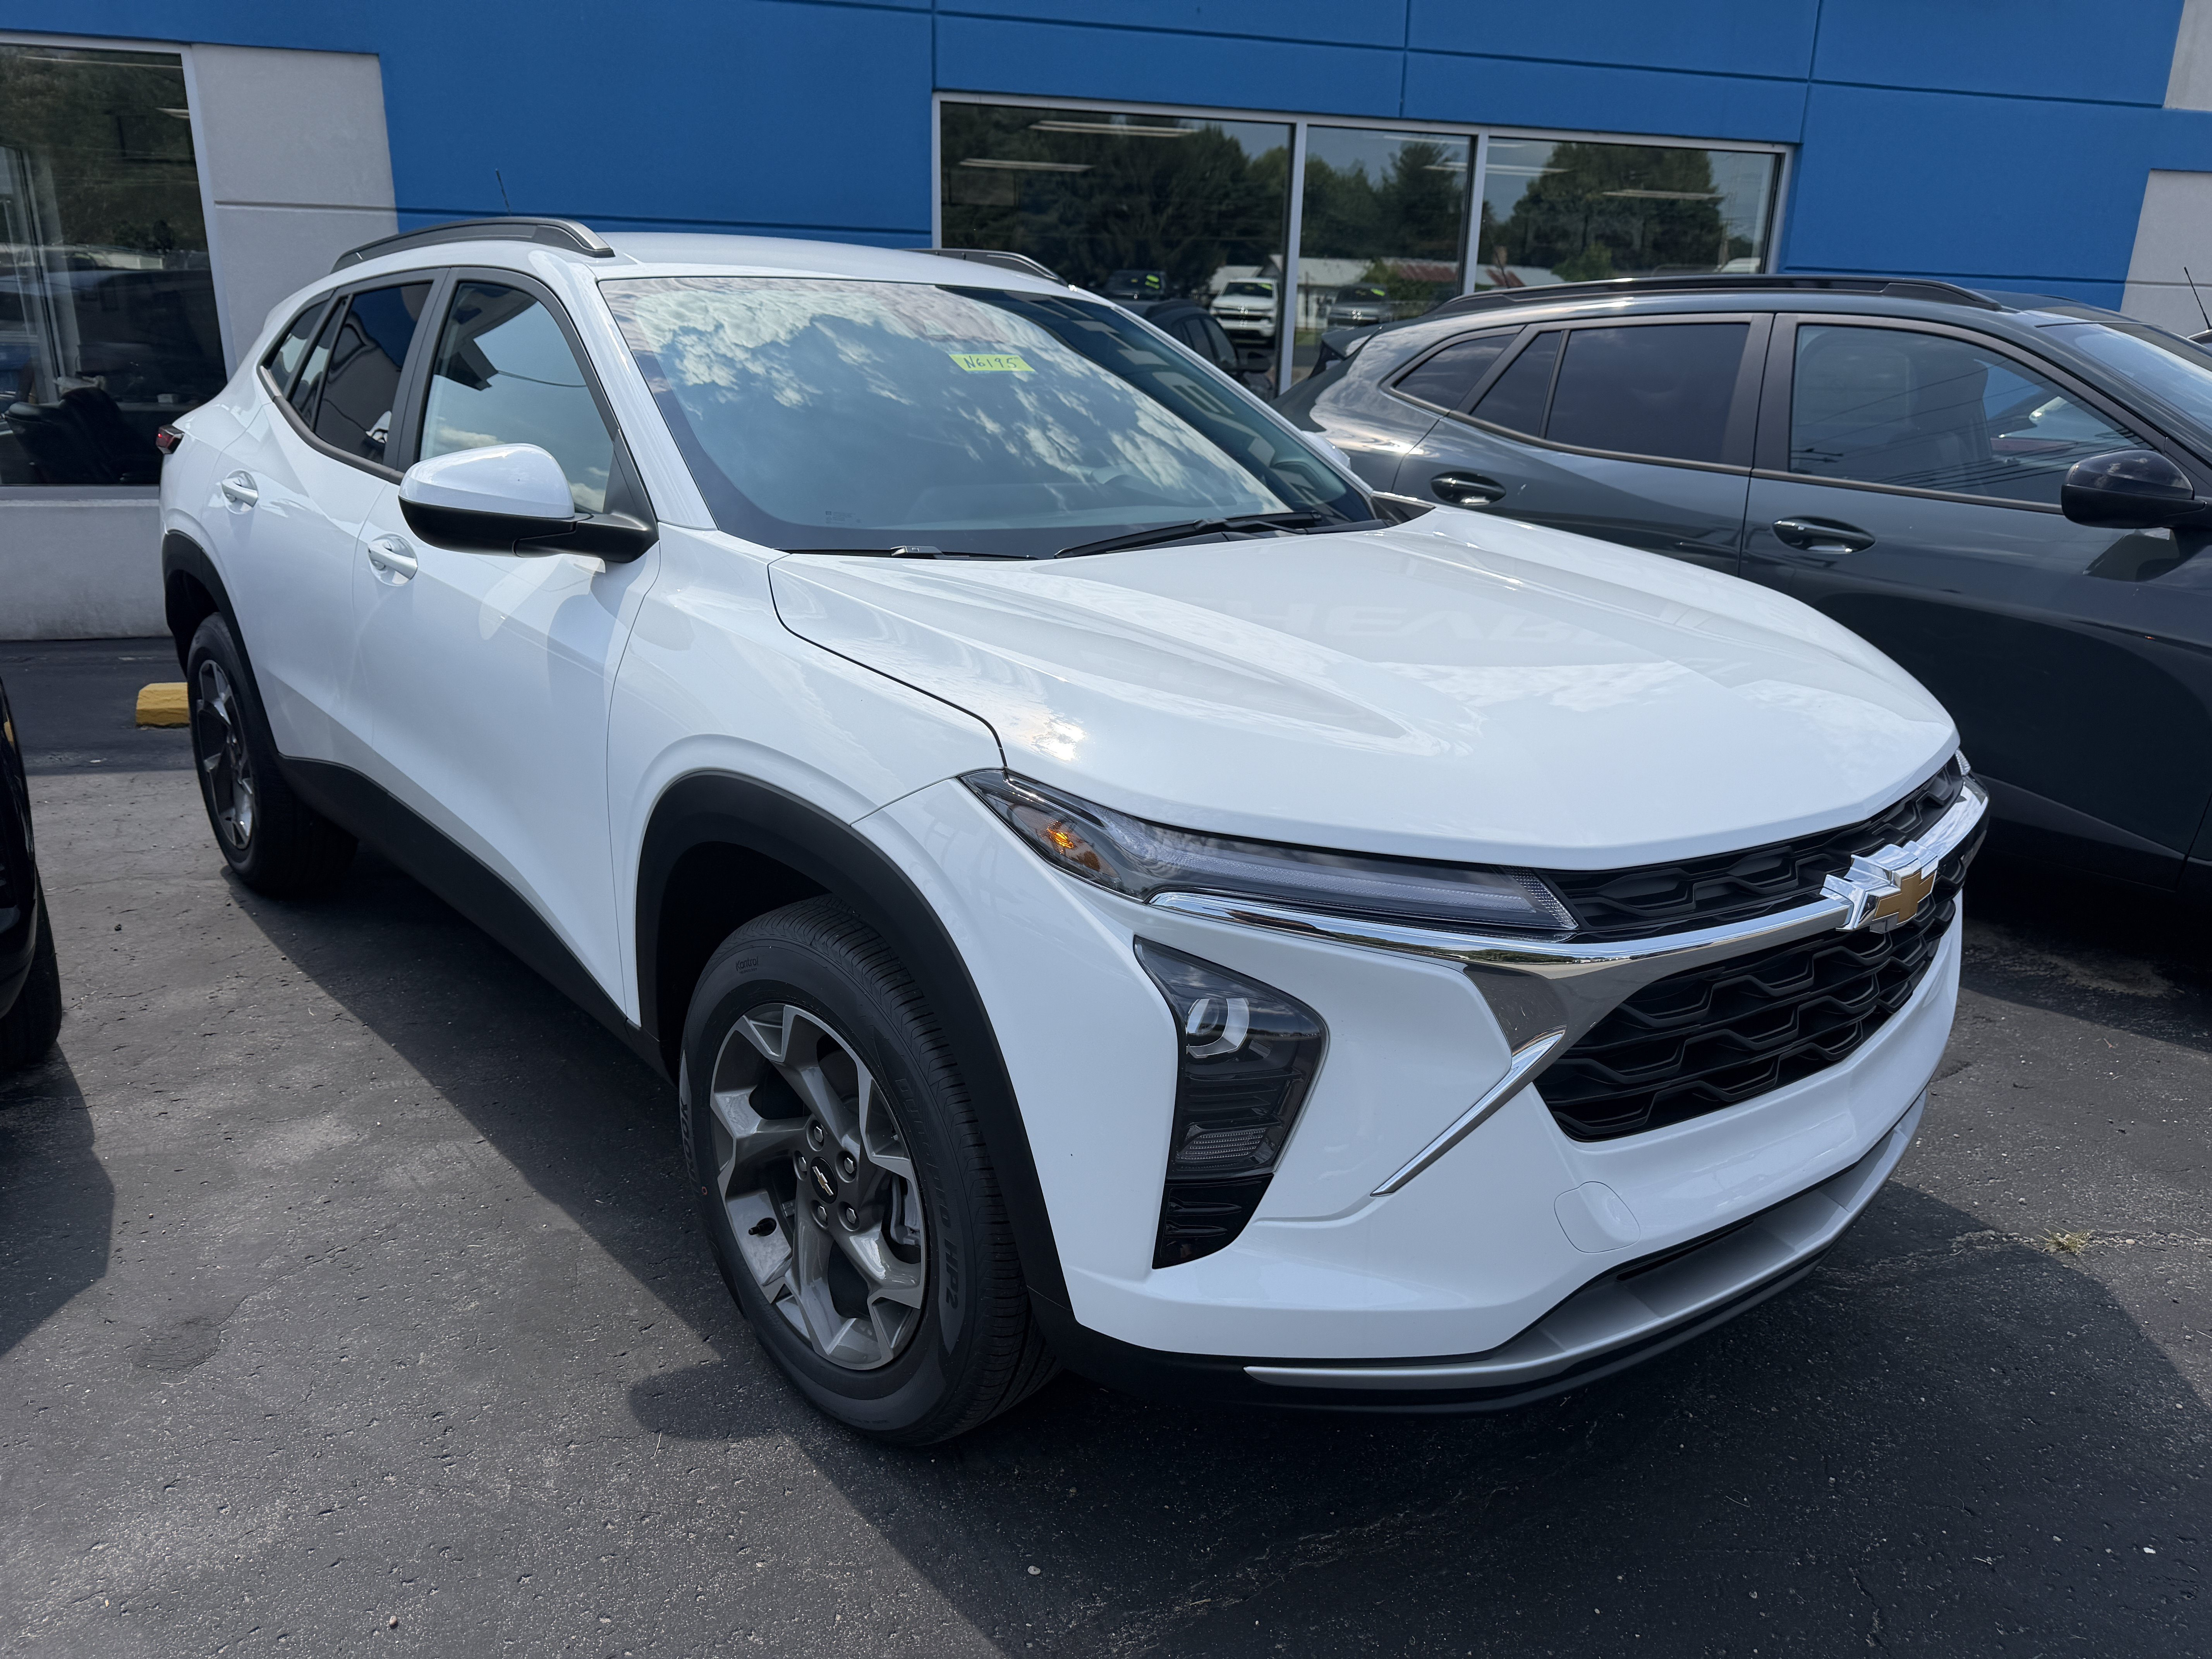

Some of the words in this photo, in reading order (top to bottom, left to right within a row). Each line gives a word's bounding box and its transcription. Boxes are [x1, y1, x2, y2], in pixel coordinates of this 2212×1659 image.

[963, 356, 1018, 368] N6195
[736, 955, 759, 972] Kontrol
[944, 1238, 959, 1309] HP2
